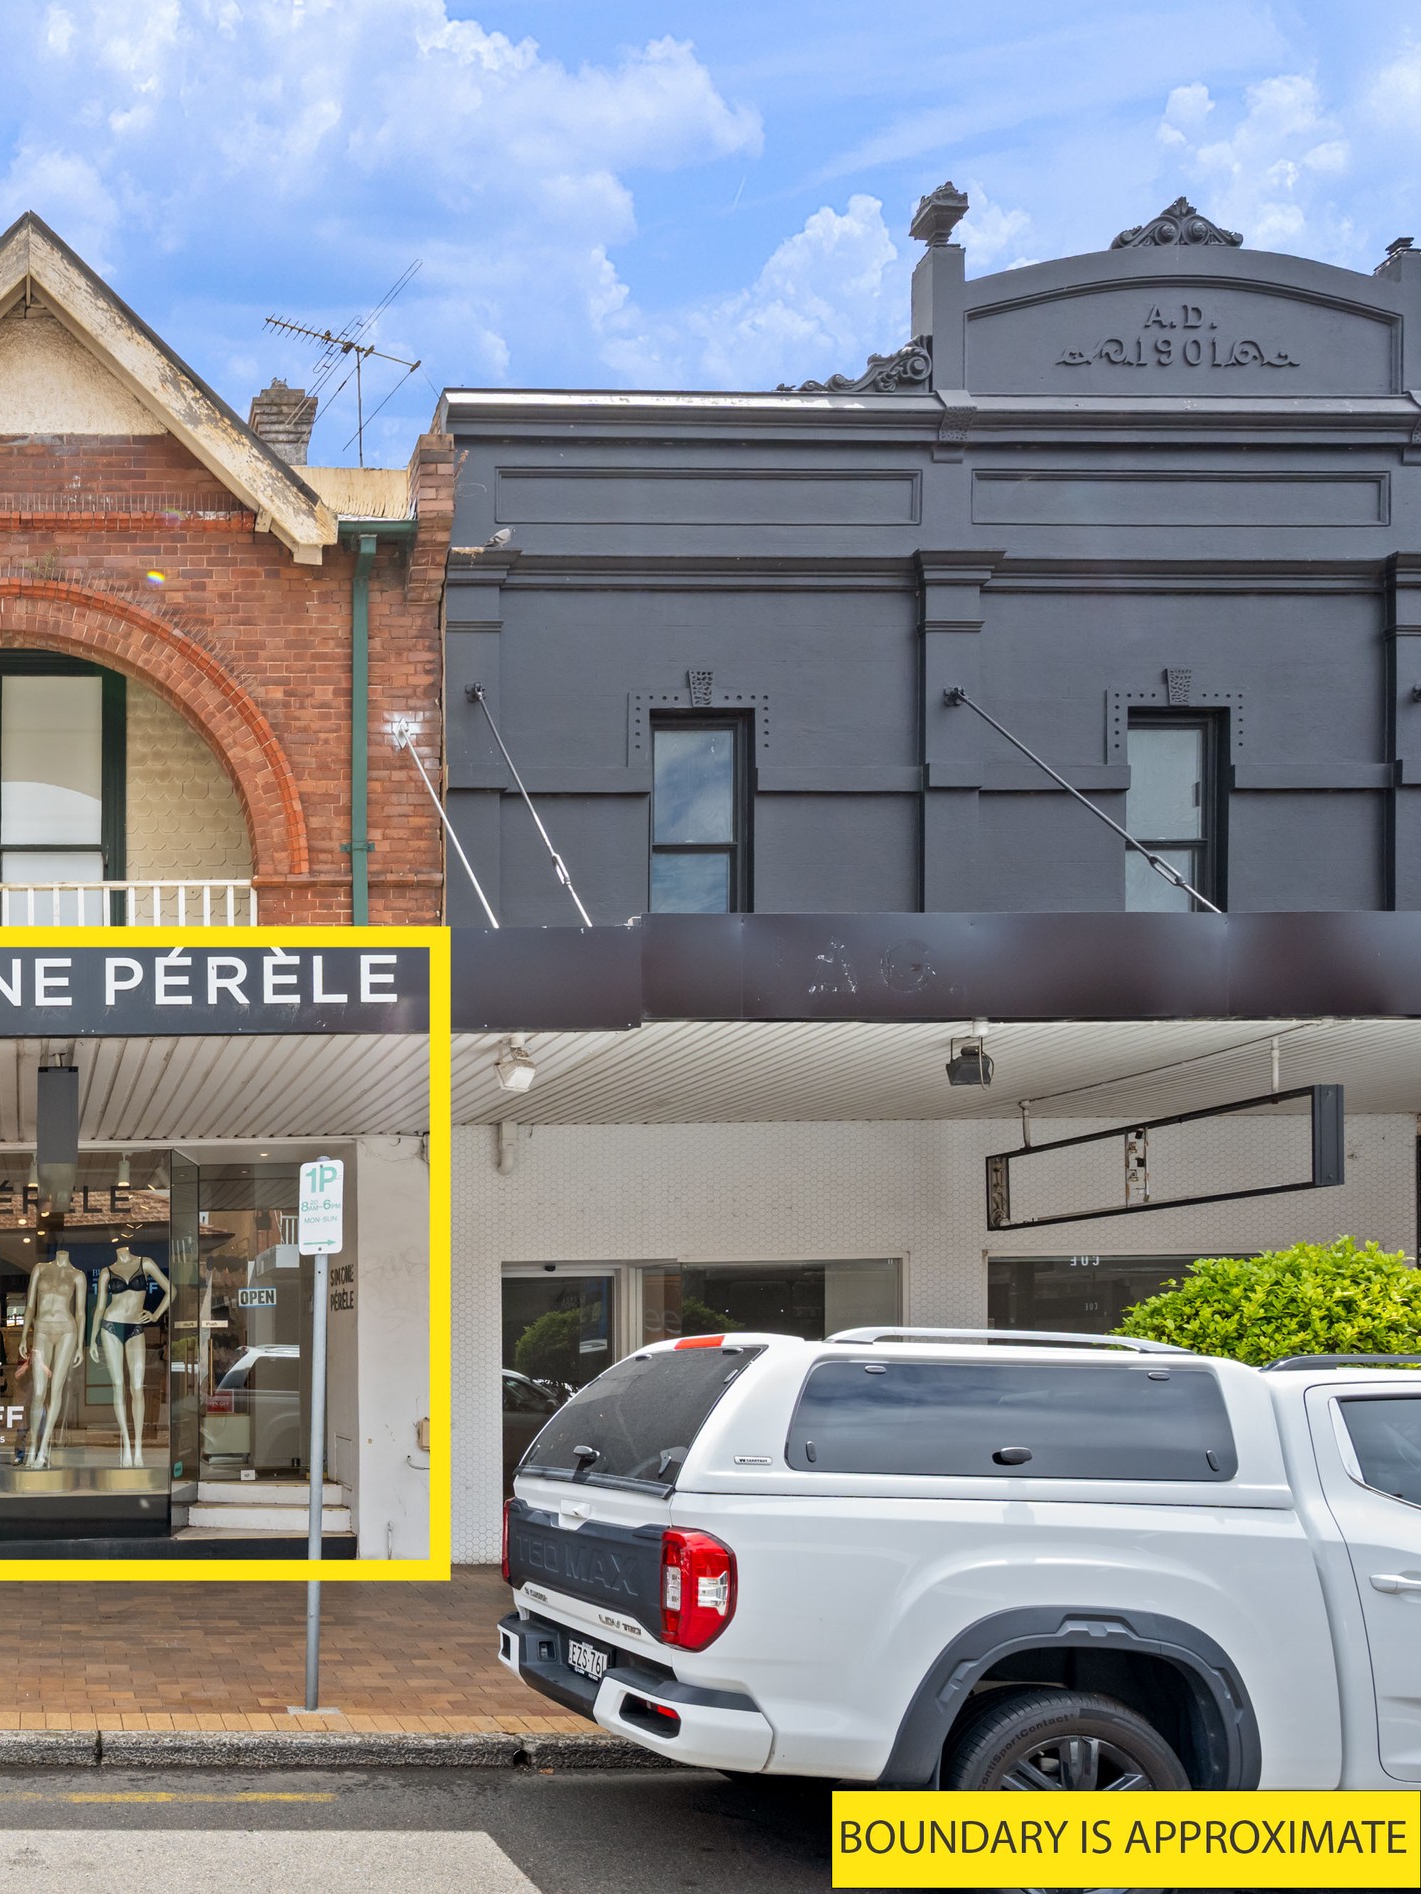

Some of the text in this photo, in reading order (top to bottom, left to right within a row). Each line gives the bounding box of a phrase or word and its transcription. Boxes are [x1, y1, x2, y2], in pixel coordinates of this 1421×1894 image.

[1136, 336, 1223, 366] 1901
[104, 947, 398, 1007] PÉRÈLE
[305, 1166, 338, 1193] 1P
[240, 1289, 275, 1305] OPEN
